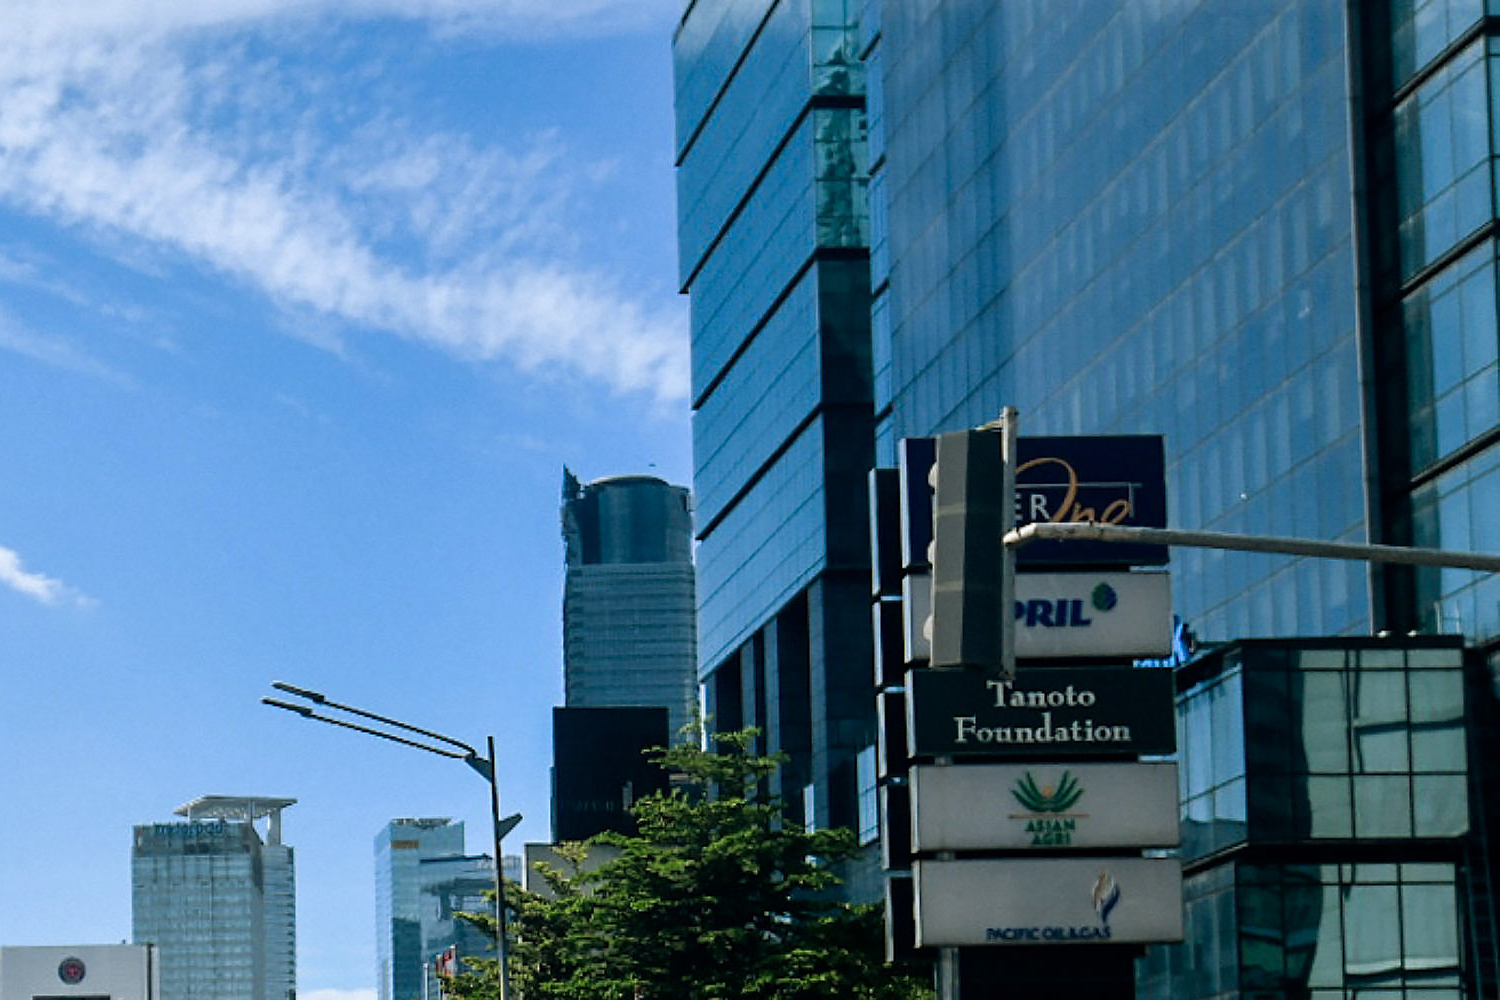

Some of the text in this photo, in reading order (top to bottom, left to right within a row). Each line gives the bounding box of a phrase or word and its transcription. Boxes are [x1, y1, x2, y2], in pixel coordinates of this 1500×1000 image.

[986, 680, 1096, 708] Tanoto
[953, 712, 1132, 743] Foundation
[1025, 819, 1075, 832] ASIAN
[986, 927, 1040, 940] PACIFIC
